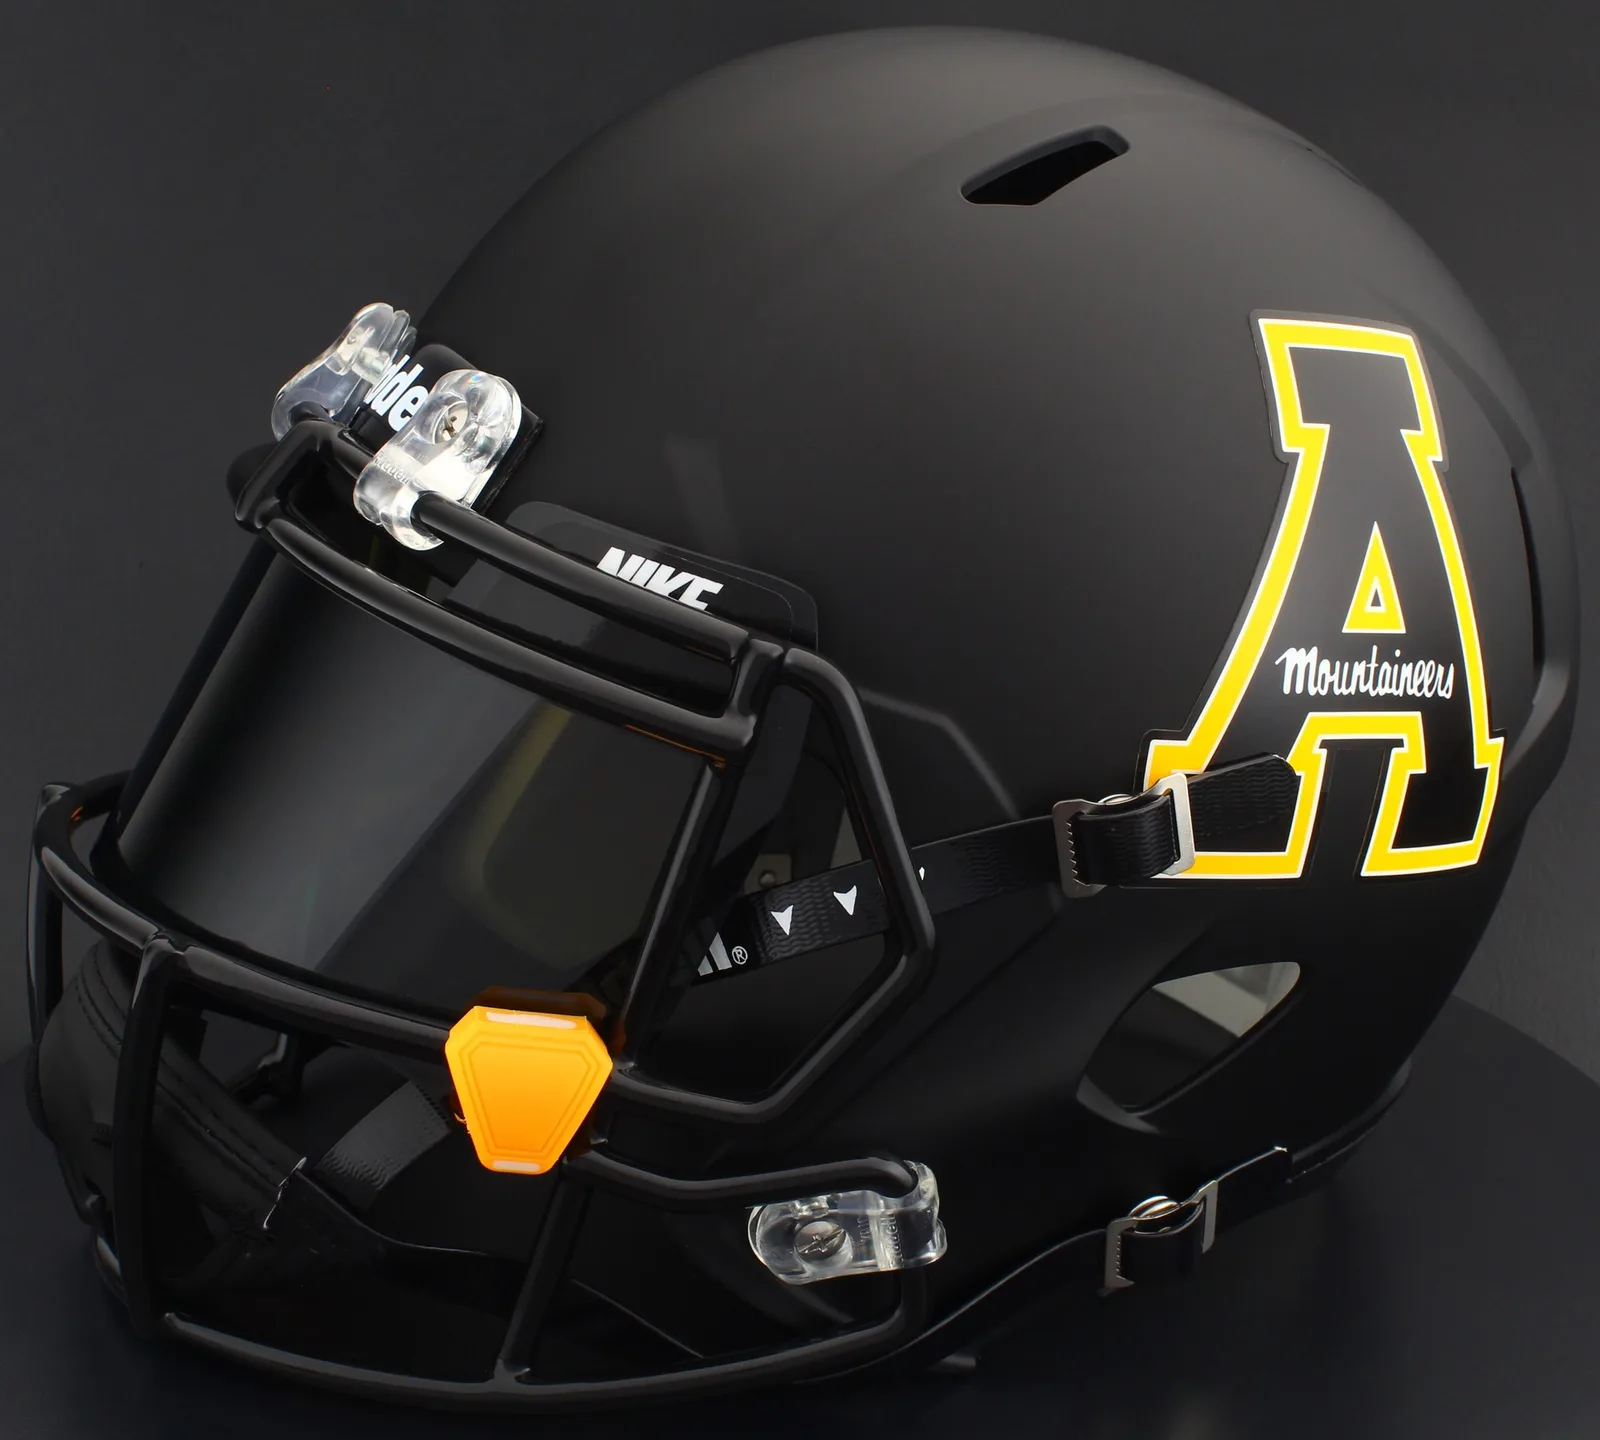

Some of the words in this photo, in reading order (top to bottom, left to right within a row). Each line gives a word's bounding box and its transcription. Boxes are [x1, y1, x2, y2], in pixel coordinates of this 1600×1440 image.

[596, 546, 724, 612] NIKE
[1144, 318, 1504, 878] A
[1274, 645, 1455, 700] Mountaineers
